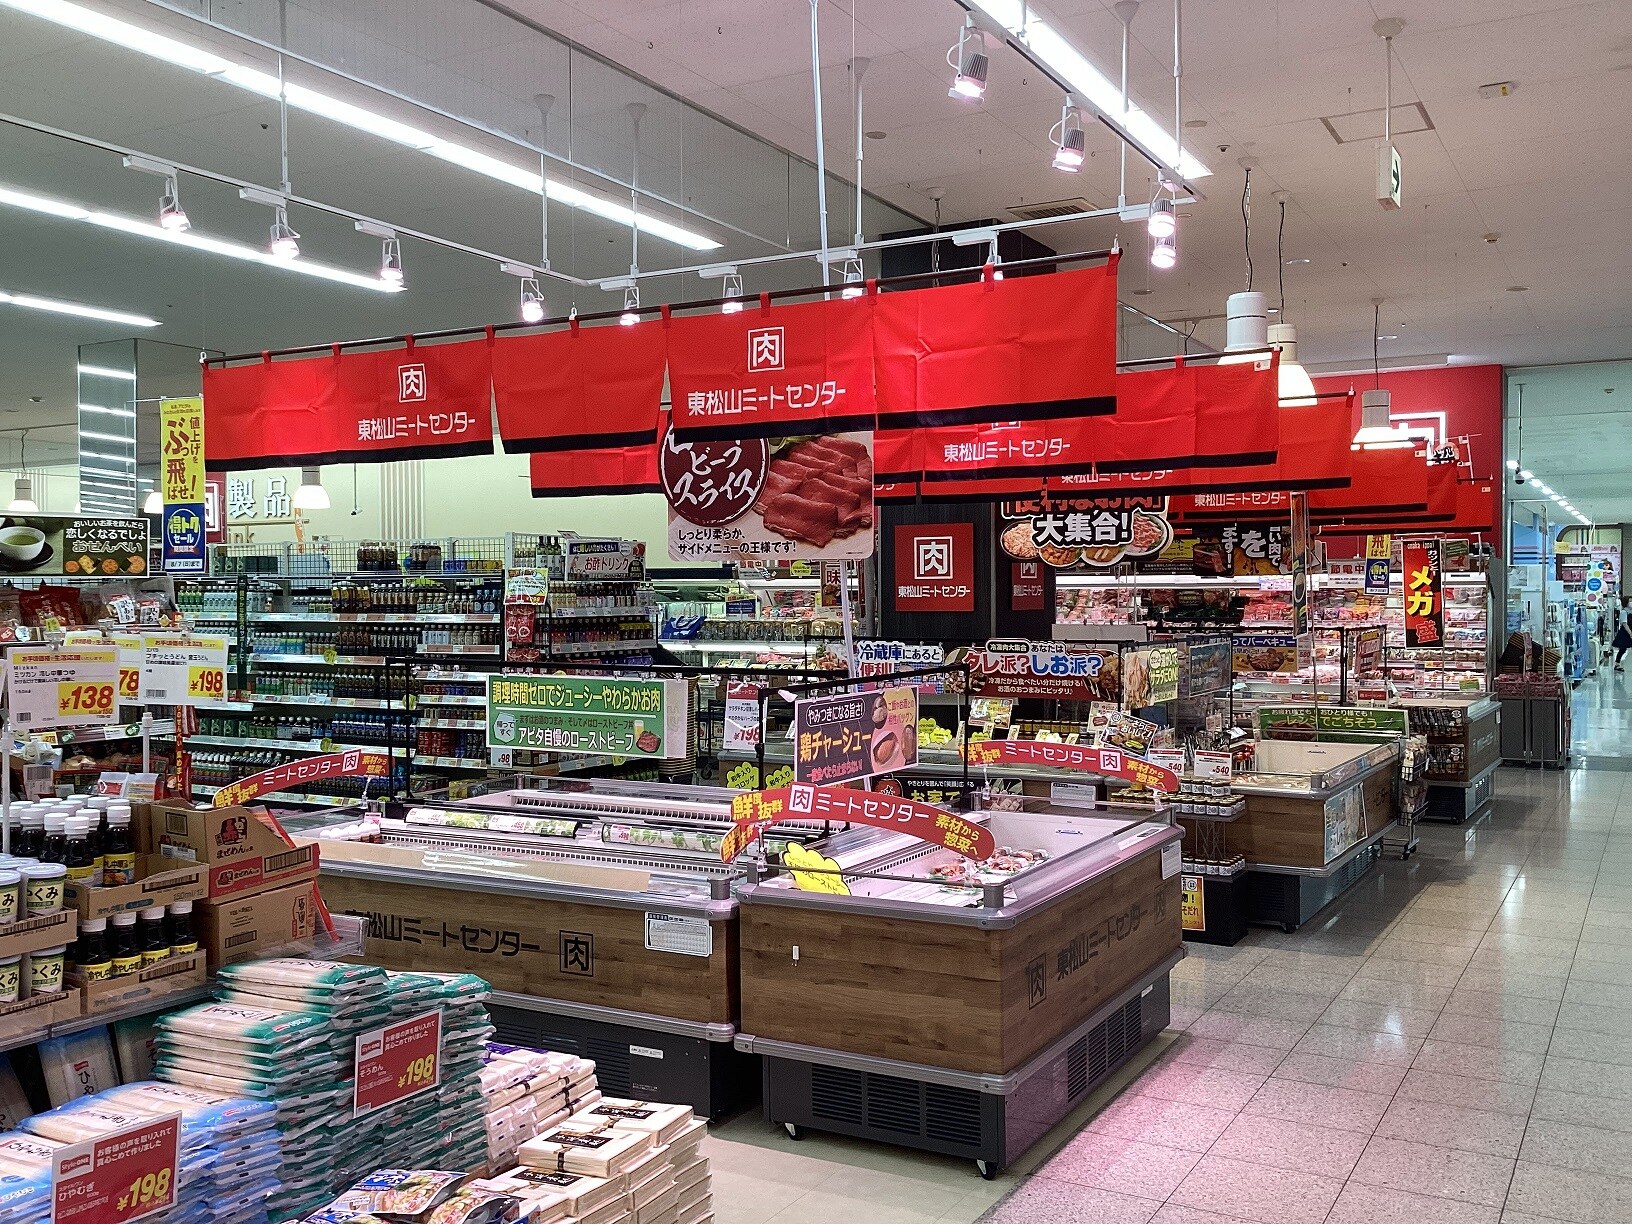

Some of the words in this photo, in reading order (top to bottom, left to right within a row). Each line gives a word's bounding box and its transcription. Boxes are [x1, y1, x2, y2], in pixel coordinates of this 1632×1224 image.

[752, 332, 779, 367] 肉
[402, 368, 422, 398] 肉
[687, 381, 846, 416] 東松山ミートセンター
[358, 412, 475, 440] 東松山ミートセンター
[190, 416, 200, 464] 値上げを
[944, 437, 1071, 462] 東松山ミートセンター
[229, 477, 291, 518] 製品
[673, 468, 754, 509] スライス
[1194, 491, 1287, 506] 東松山ミートセンター
[65, 528, 147, 540] 恋しくなるでしょ
[73, 519, 144, 530] おいしいお茶を飲んだら
[170, 516, 199, 534] 得トク
[678, 528, 746, 540] しっとり柔らか、
[1036, 512, 1128, 543] 大集合!
[72, 540, 143, 553] おせんべい
[173, 533, 195, 544] セール
[678, 541, 796, 554] サイドメニューの王様です!
[1240, 530, 1266, 558] を
[919, 541, 948, 575] 肉
[1330, 564, 1364, 574] 節電中
[897, 585, 971, 598] 東松山ミートセンター
[1407, 566, 1433, 616] メガ
[860, 643, 940, 660] 冷蔵庫にあると
[1031, 644, 1064, 653] あなたは
[860, 662, 892, 676] 便利
[190, 670, 224, 692] ¥198
[988, 678, 1084, 687] 冷凍だから食べたい分だけ焼ける!
[60, 685, 114, 710] ¥138
[492, 681, 661, 712] 調理時間ゼロでジューシーやわらかお肉
[807, 702, 863, 724] やみつきになる旨さ!
[499, 728, 511, 736] すぐ
[1121, 726, 1152, 740] おいしく!
[1133, 720, 1150, 731] さらに
[518, 727, 634, 751] アピタ自慢のローストビーフ
[800, 726, 872, 762] 鶏チャーシュー
[344, 755, 356, 768] 肉
[1005, 742, 1096, 763] ミートセンター
[1102, 754, 1118, 769] 肉
[263, 761, 341, 785] ミートセンター
[731, 767, 750, 782] 和牛入り
[769, 771, 790, 786] 和牛入り
[1126, 760, 1165, 779] 素材から
[1136, 772, 1166, 789] 惣菜へ
[733, 792, 783, 820] 鮮度抜群
[793, 788, 811, 809] 肉
[816, 793, 929, 822] ミートセンター
[935, 813, 980, 841] 素材から
[944, 831, 979, 856] 惣菜へ
[1057, 903, 1148, 982] 東松山ミートセンター
[564, 936, 590, 972] 肉
[1031, 963, 1045, 1003] 肉
[385, 1020, 436, 1042] お客様の声を取り入れて
[359, 1064, 384, 1078] そうめん
[398, 1053, 435, 1088] ¥198
[97, 1127, 172, 1157] お客様の声を取り入れて
[97, 1140, 162, 1167] 真心こめて作りました
[59, 1182, 95, 1201] ひやむぎ
[117, 1168, 172, 1211] ¥198
